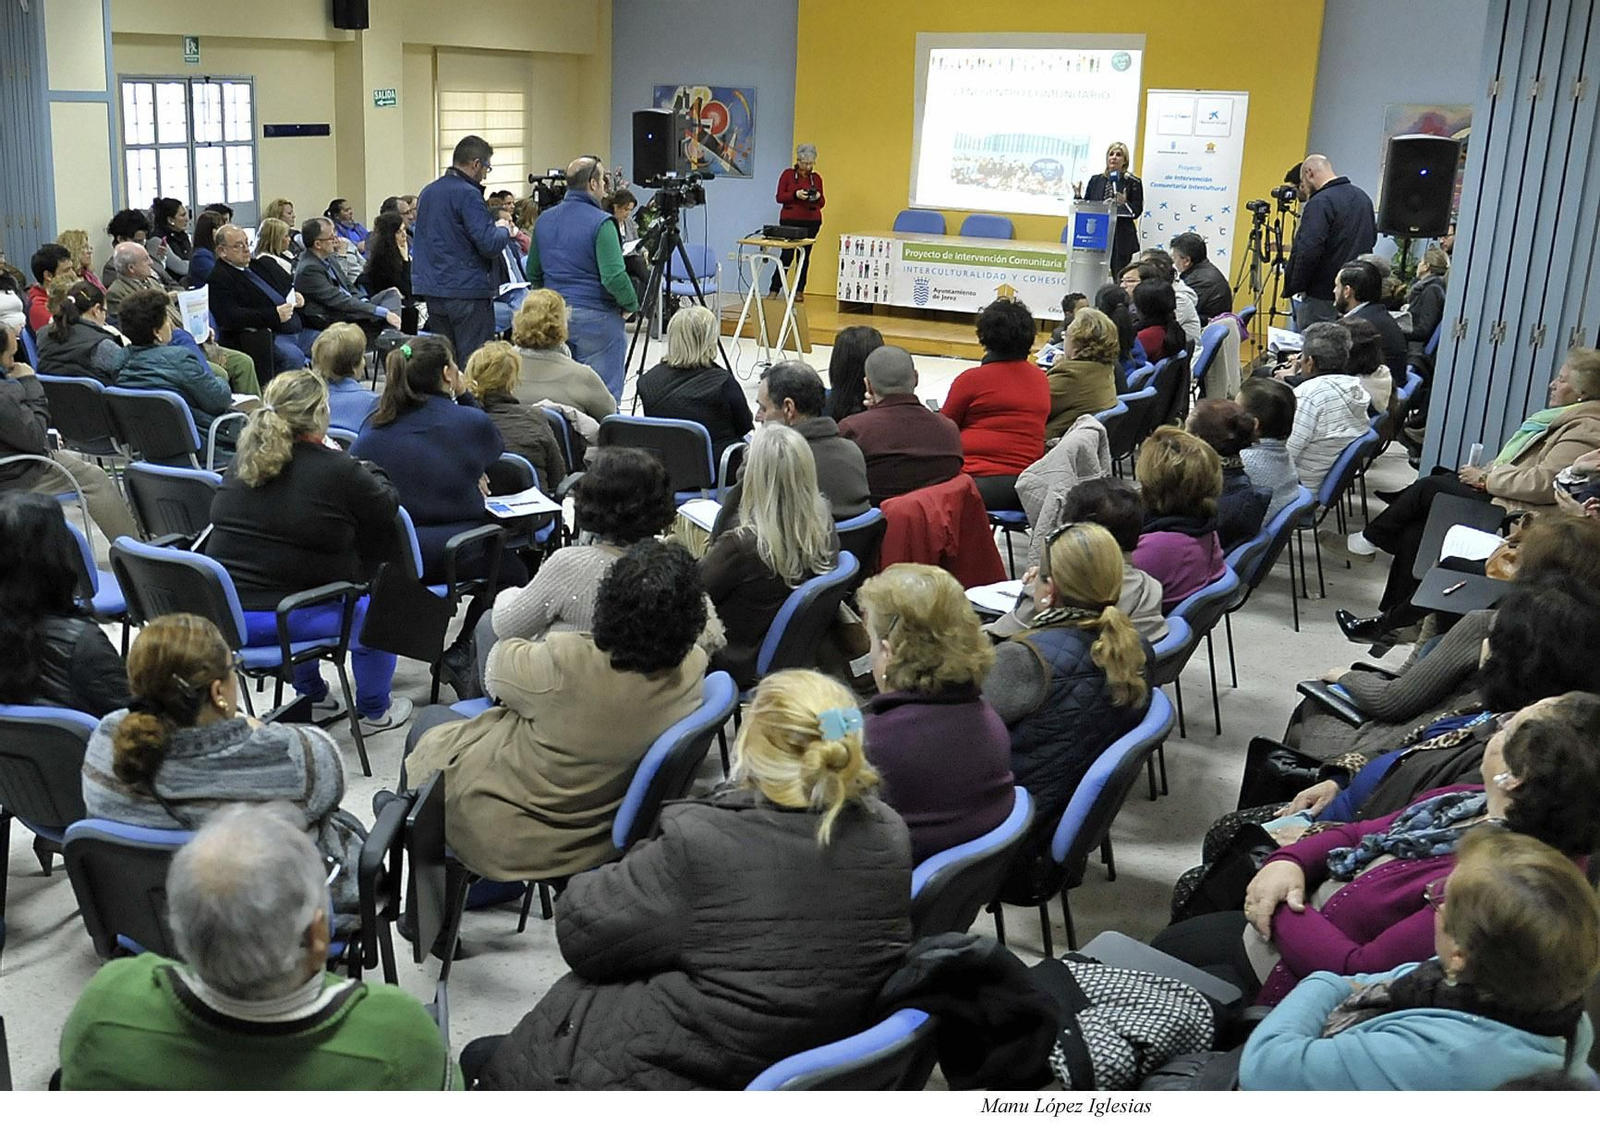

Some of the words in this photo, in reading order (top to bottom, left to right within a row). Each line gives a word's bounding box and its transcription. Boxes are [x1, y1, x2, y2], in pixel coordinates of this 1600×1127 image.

[374, 89, 395, 100] SALIDA
[1150, 181, 1187, 190] Comunitaria
[1188, 183, 1227, 192] Intercultural
[905, 249, 941, 260] Proyecto
[942, 251, 954, 260] de
[955, 251, 1007, 263] Intervención
[1009, 255, 1062, 268] Comunitaria
[903, 265, 1007, 280] INTERCULTURALIDAD
[1012, 273, 1018, 281] Y
[933, 287, 977, 297] Ayuntamiento
